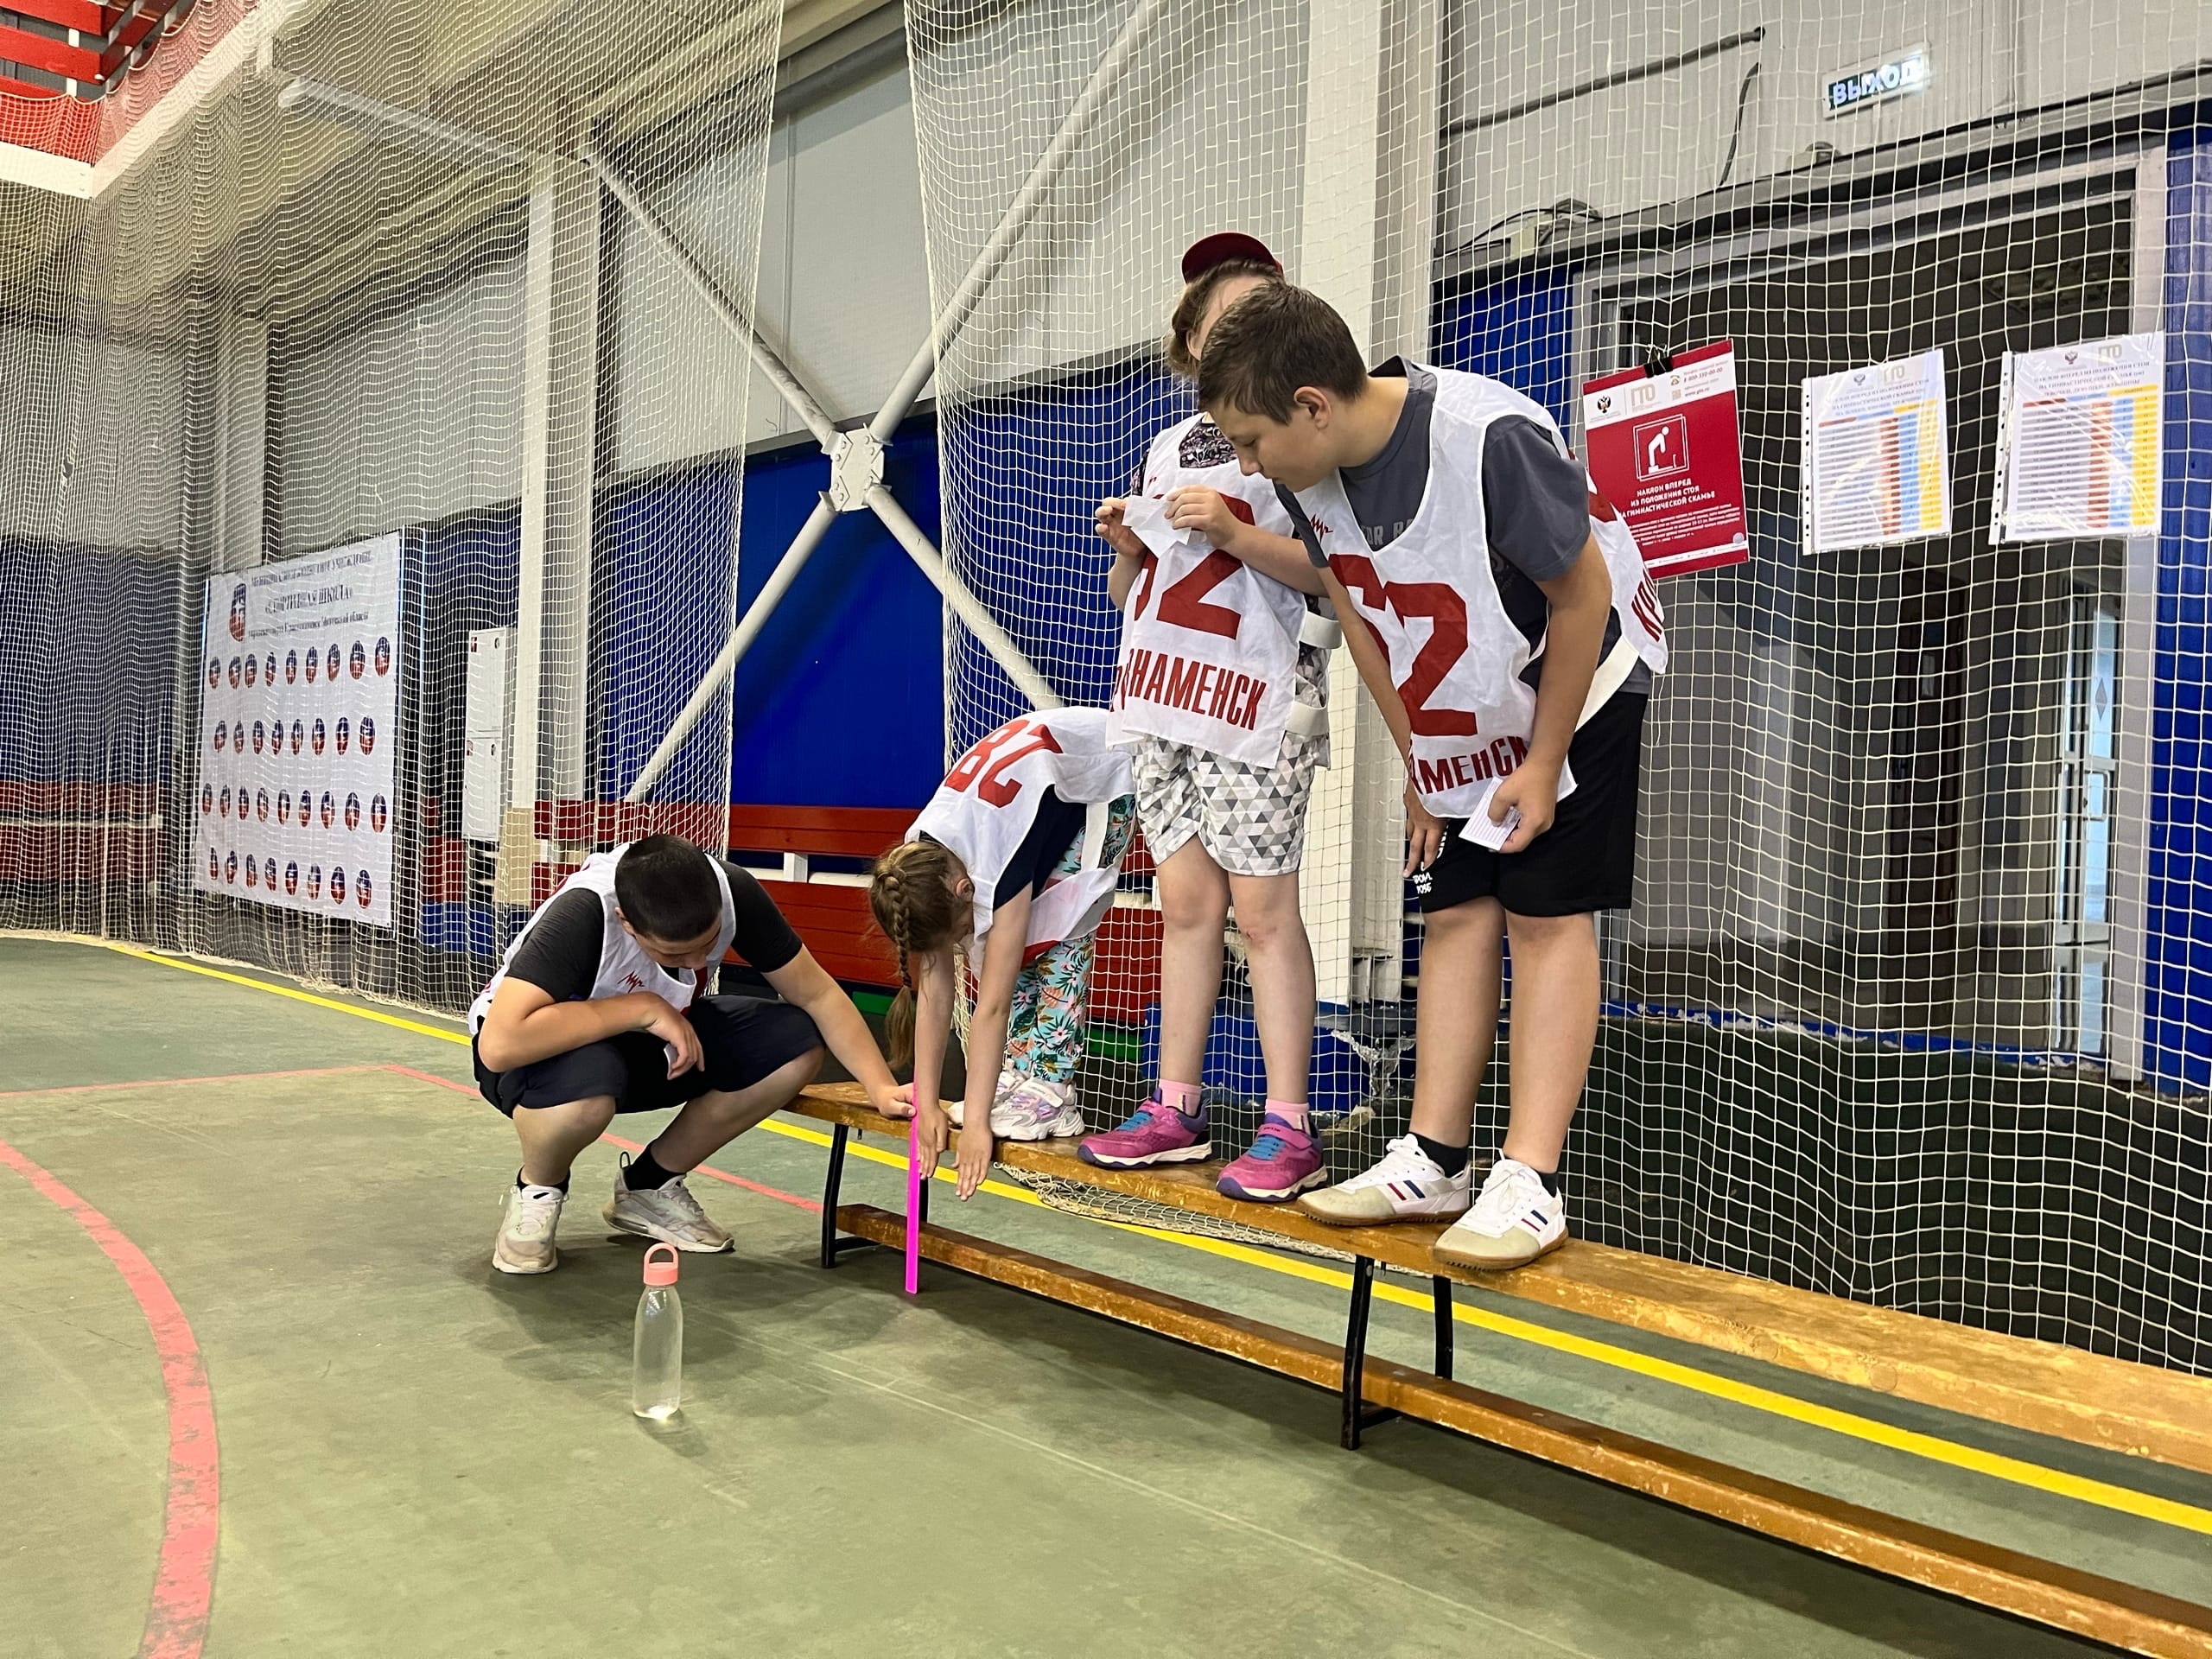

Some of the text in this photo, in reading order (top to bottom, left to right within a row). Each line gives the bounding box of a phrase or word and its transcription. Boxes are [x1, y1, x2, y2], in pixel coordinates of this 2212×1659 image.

[1627, 496, 1687, 517] ГИМНАСТИЧЕСКОЙ
[1688, 491, 1715, 503] СКАМЬЕ
[1637, 478, 1692, 497] НАКЛОН ВПЕРЕД
[1640, 490, 1682, 505] ПОЛОЖЕНИЯ
[1683, 486, 1700, 495] СТОЯ
[1135, 493, 1255, 640] 2
[1126, 648, 1267, 730] НАМЕНСК
[1409, 736, 1529, 795] МЕНСК
